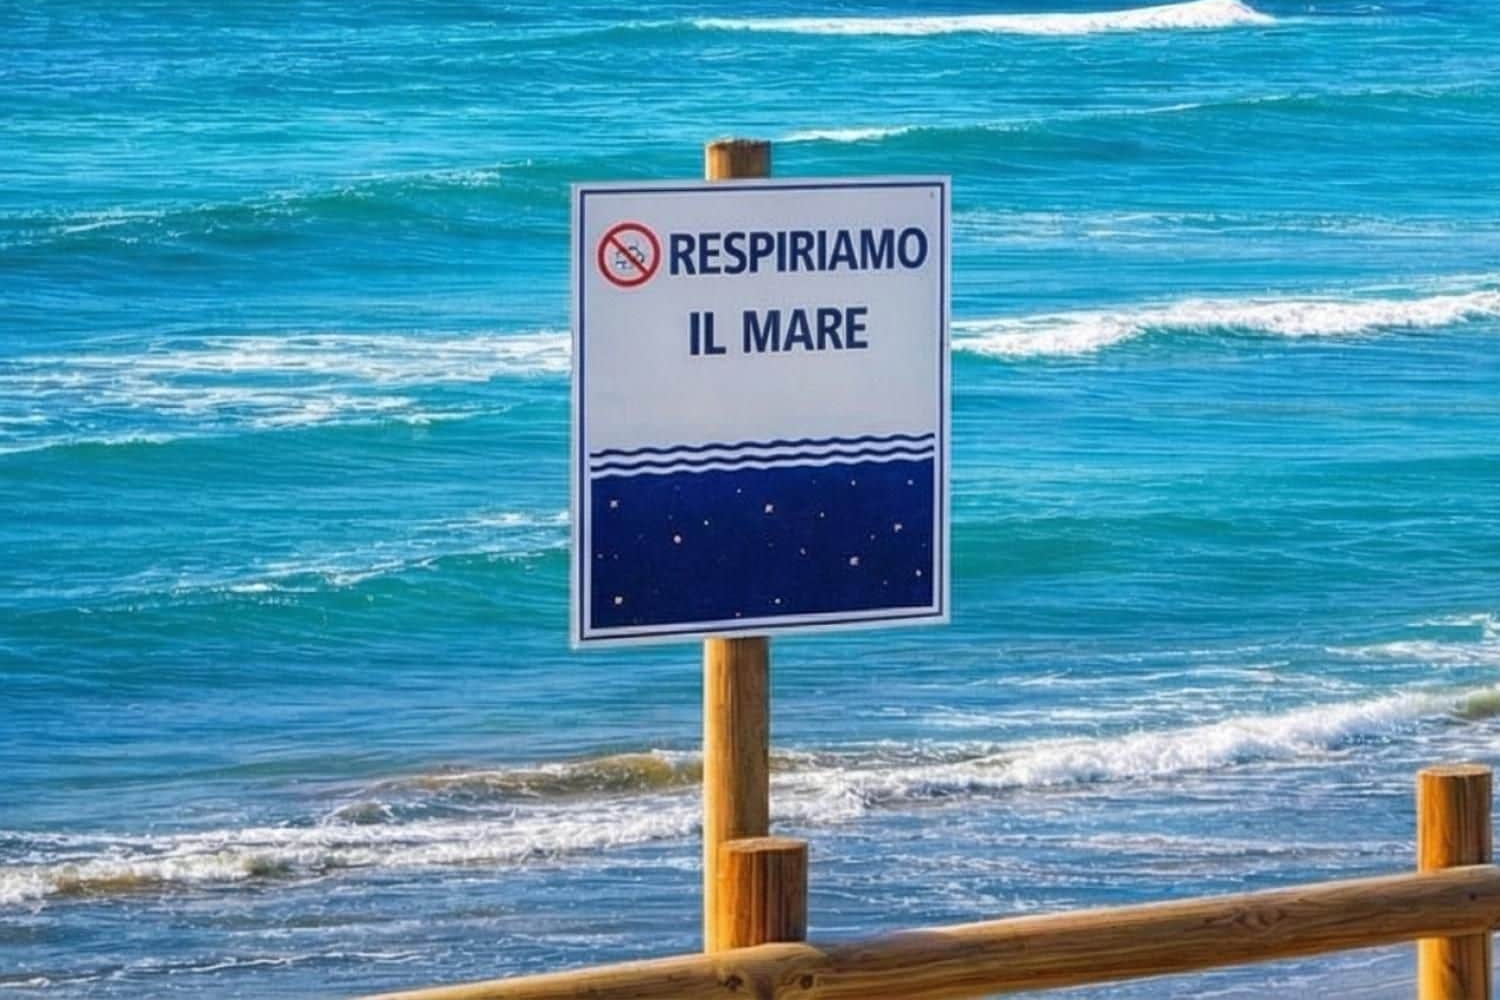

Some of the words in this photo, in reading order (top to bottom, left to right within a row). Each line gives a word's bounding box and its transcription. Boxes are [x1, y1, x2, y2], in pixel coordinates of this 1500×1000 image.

[669, 227, 928, 276] RESPIRIAMO
[689, 311, 727, 356] IL
[743, 307, 869, 354] MARE
